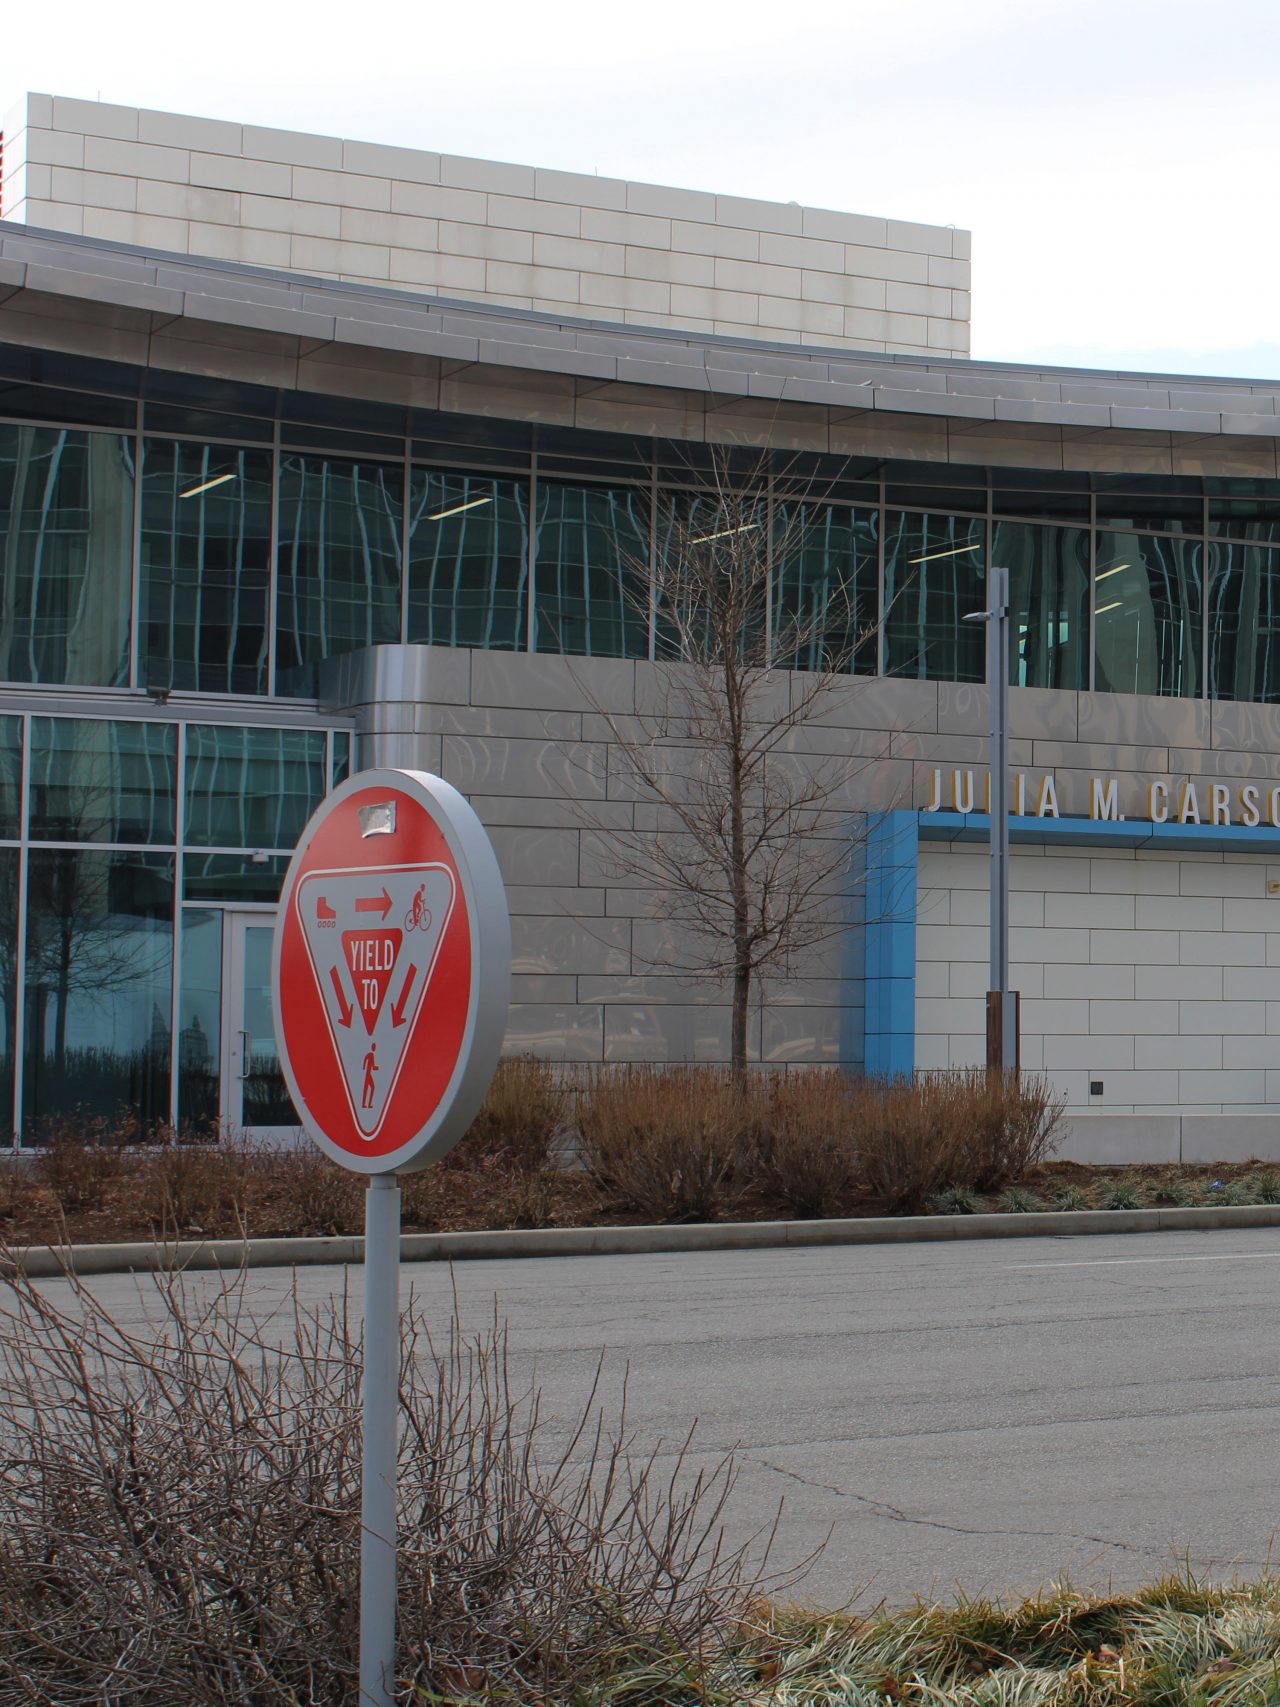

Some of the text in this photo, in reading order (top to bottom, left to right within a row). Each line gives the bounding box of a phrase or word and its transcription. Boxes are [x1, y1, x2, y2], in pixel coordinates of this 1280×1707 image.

[923, 769, 1060, 818] JUIA
[1090, 778, 1125, 821] M.
[350, 939, 395, 971] YIELD
[361, 978, 379, 1010] TO
